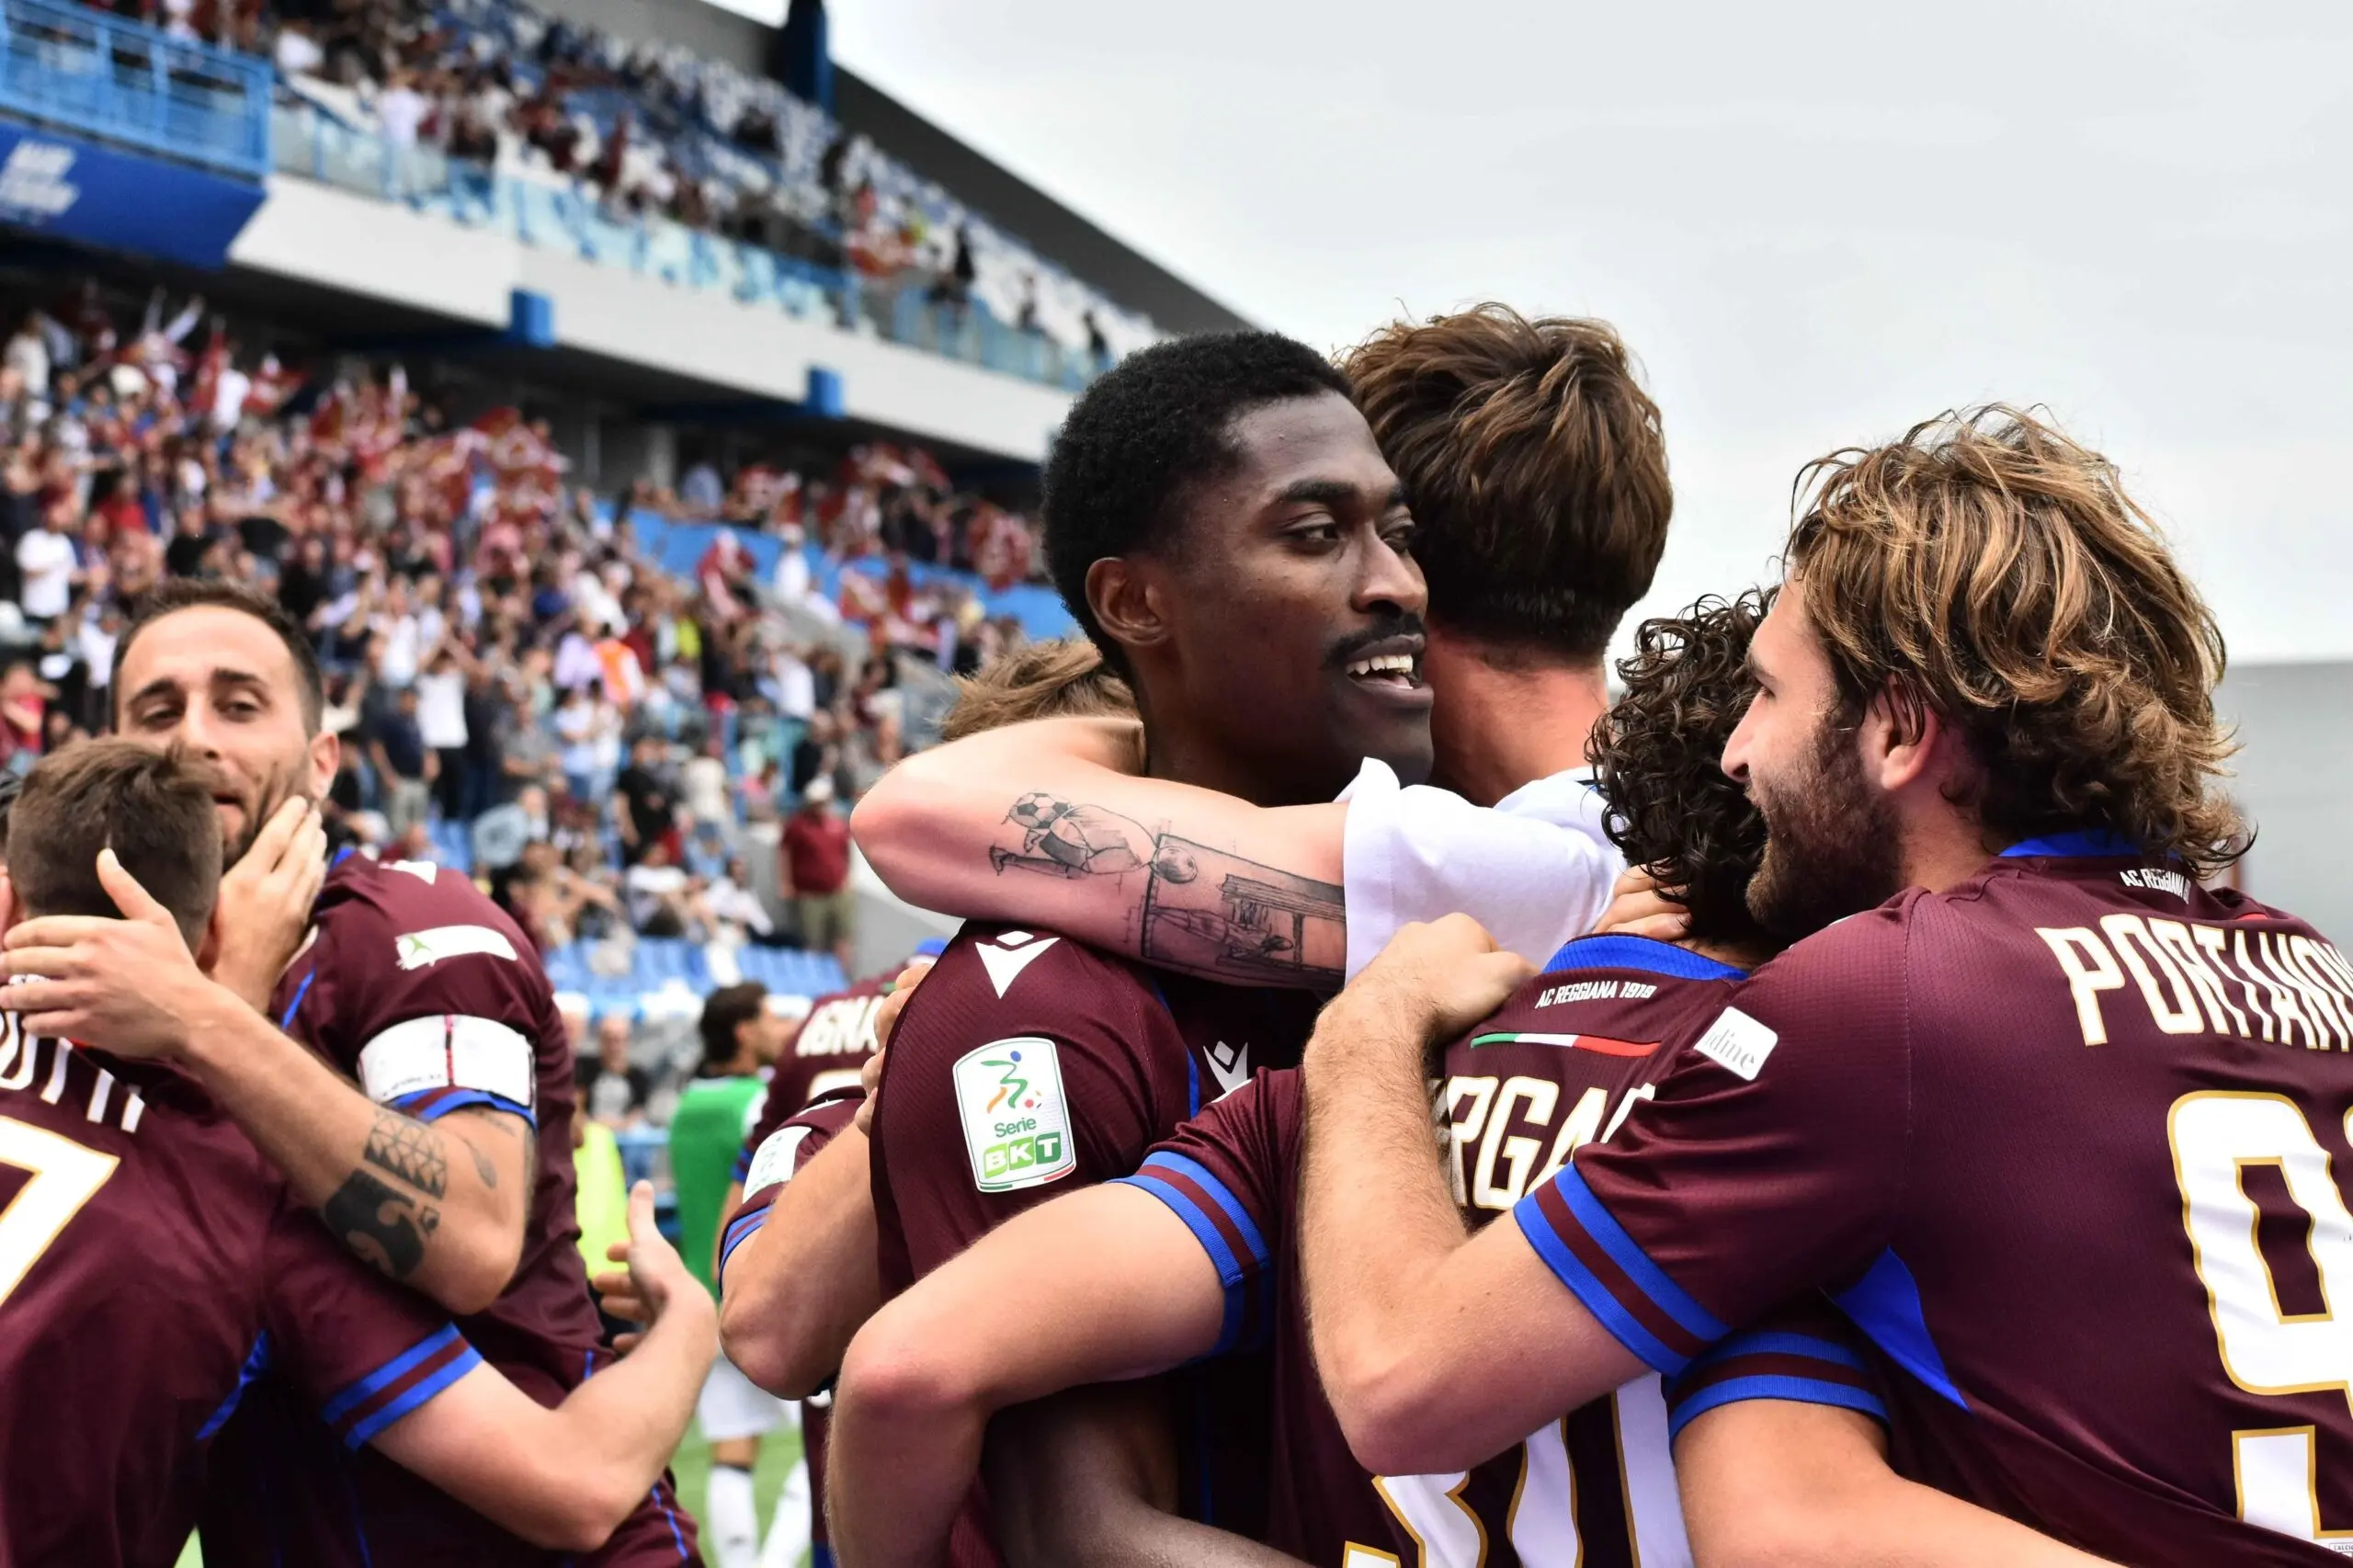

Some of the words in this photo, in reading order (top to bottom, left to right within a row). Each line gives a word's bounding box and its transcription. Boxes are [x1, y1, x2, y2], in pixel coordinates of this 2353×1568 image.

[2120, 869, 2144, 887] AC
[1534, 988, 1556, 1009] AC
[1553, 981, 1619, 1005] REGGIANA
[994, 1117, 1038, 1138] Serie
[983, 1131, 1063, 1179] BKT
